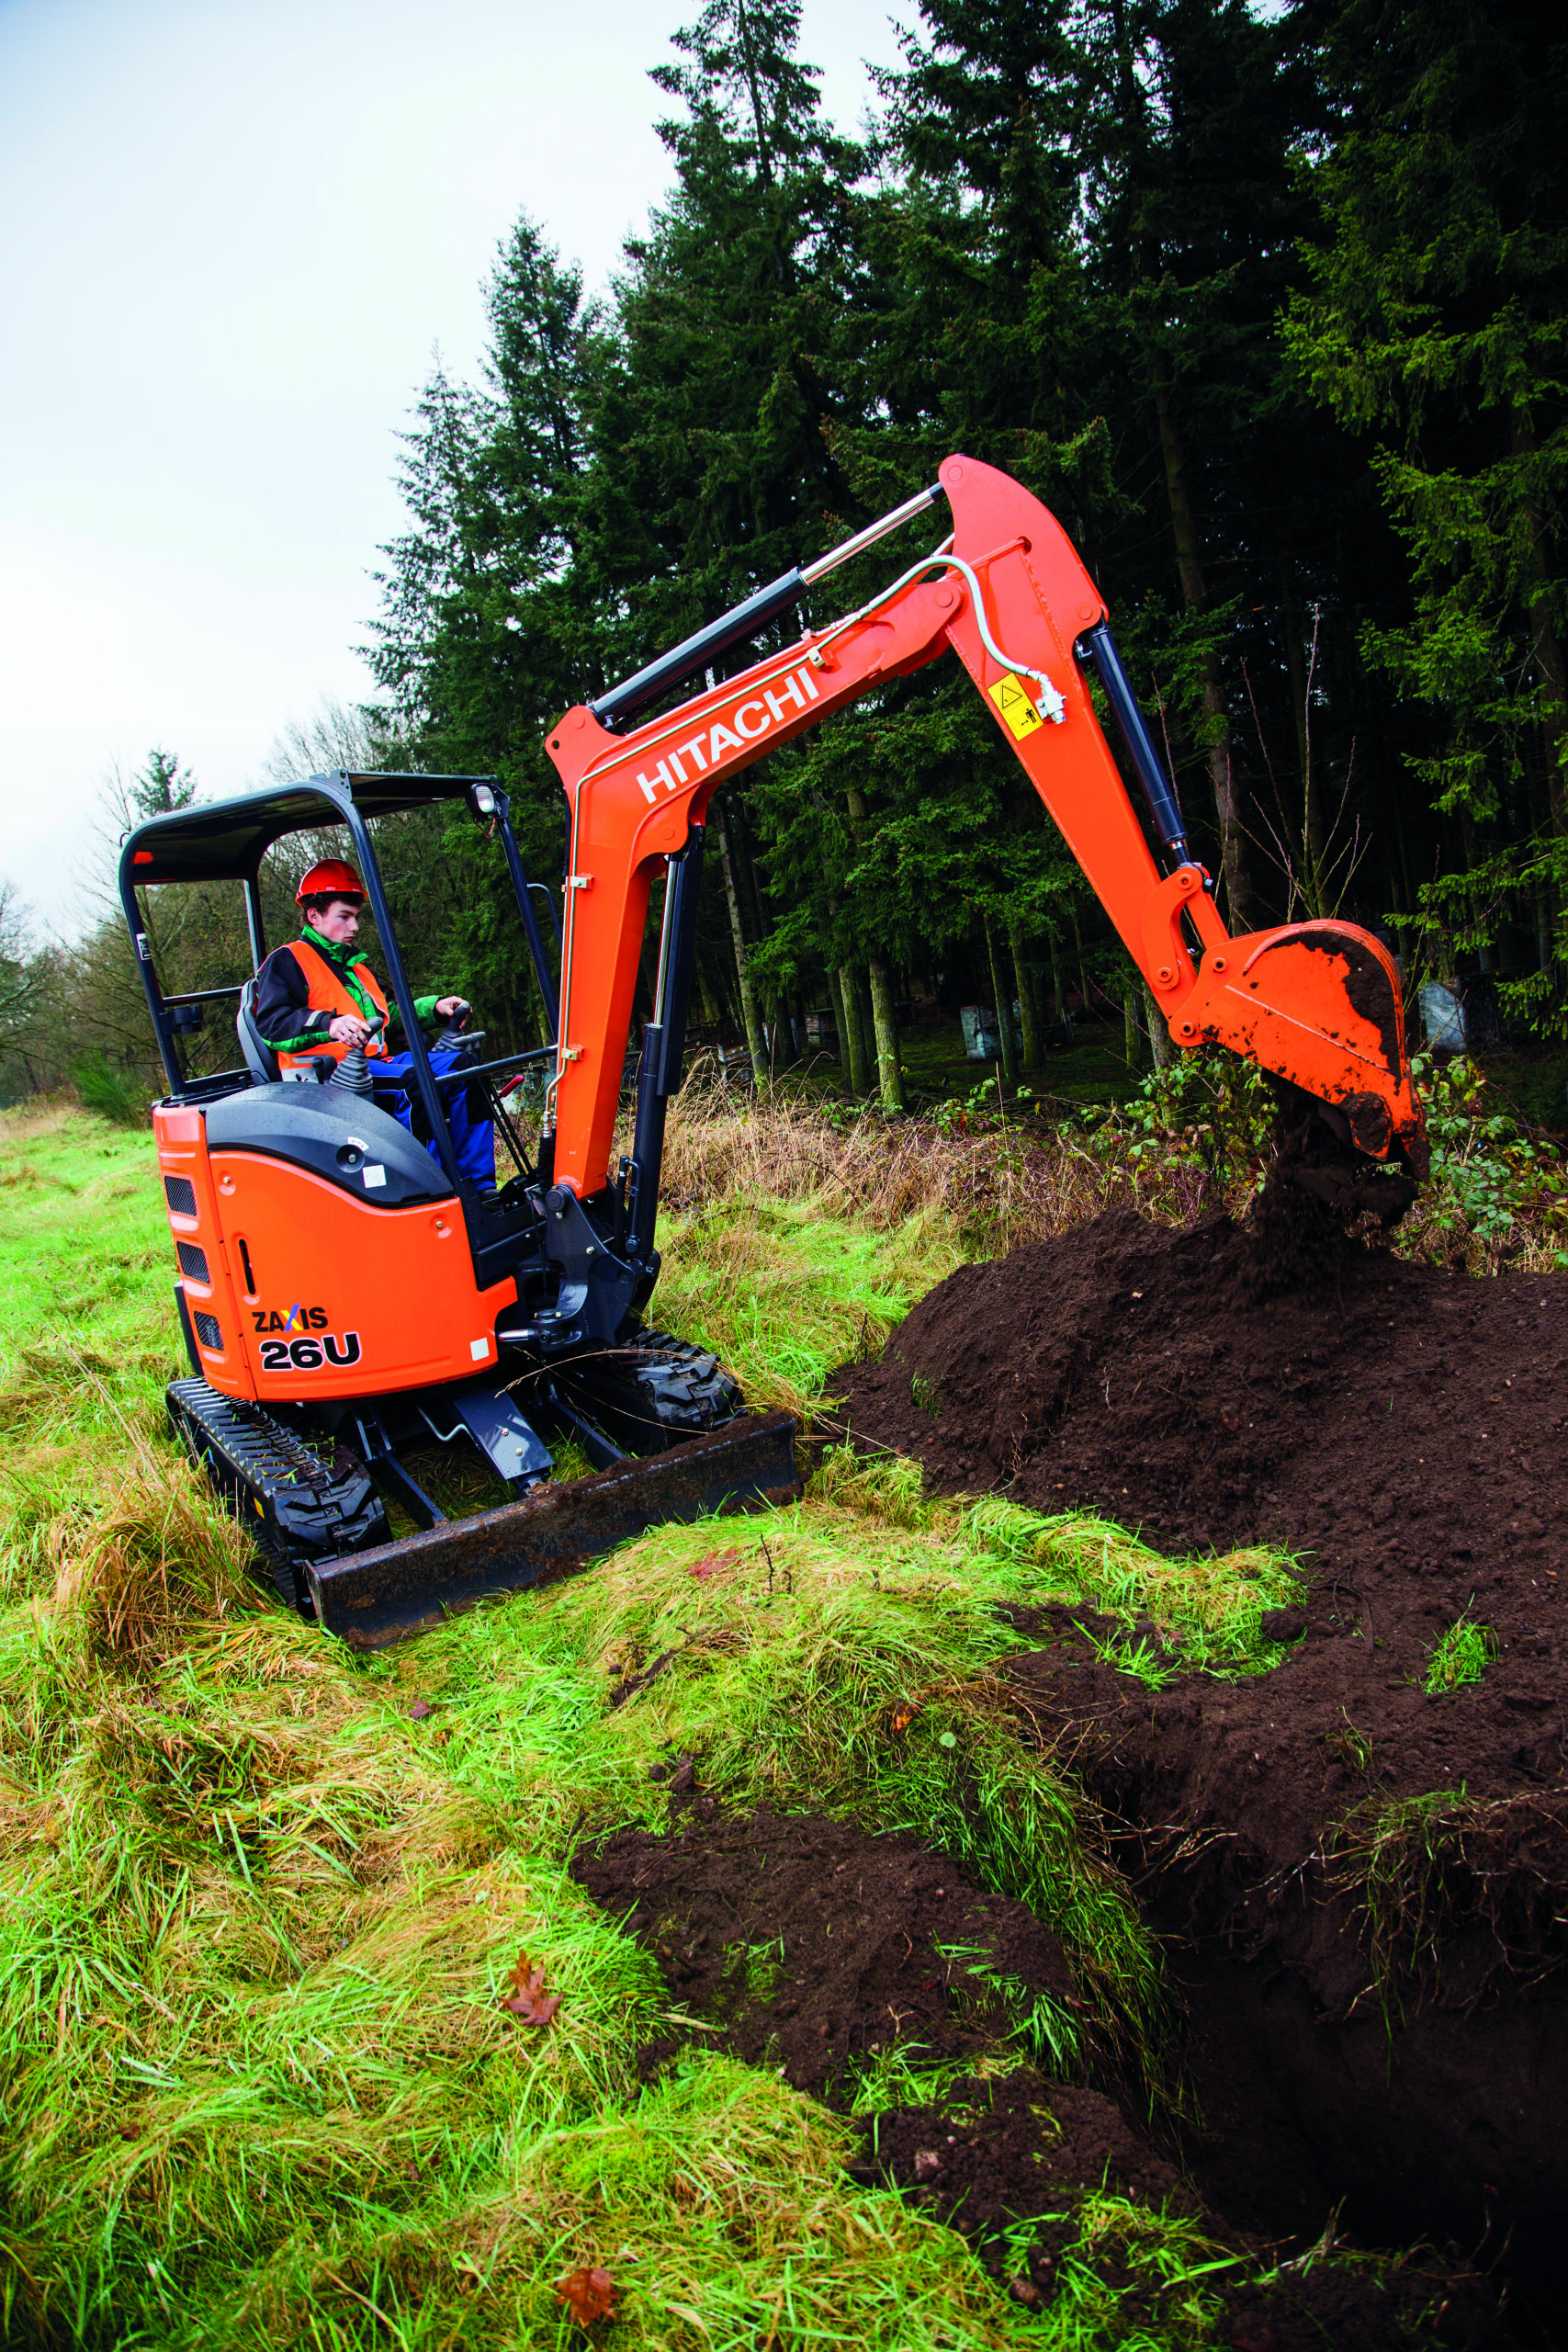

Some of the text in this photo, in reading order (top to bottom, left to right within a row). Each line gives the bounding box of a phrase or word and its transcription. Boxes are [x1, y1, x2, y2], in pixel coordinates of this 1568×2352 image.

[636, 667, 819, 804] HITACHI
[252, 1304, 328, 1332] ZAXIS
[259, 1331, 362, 1371] 26U
